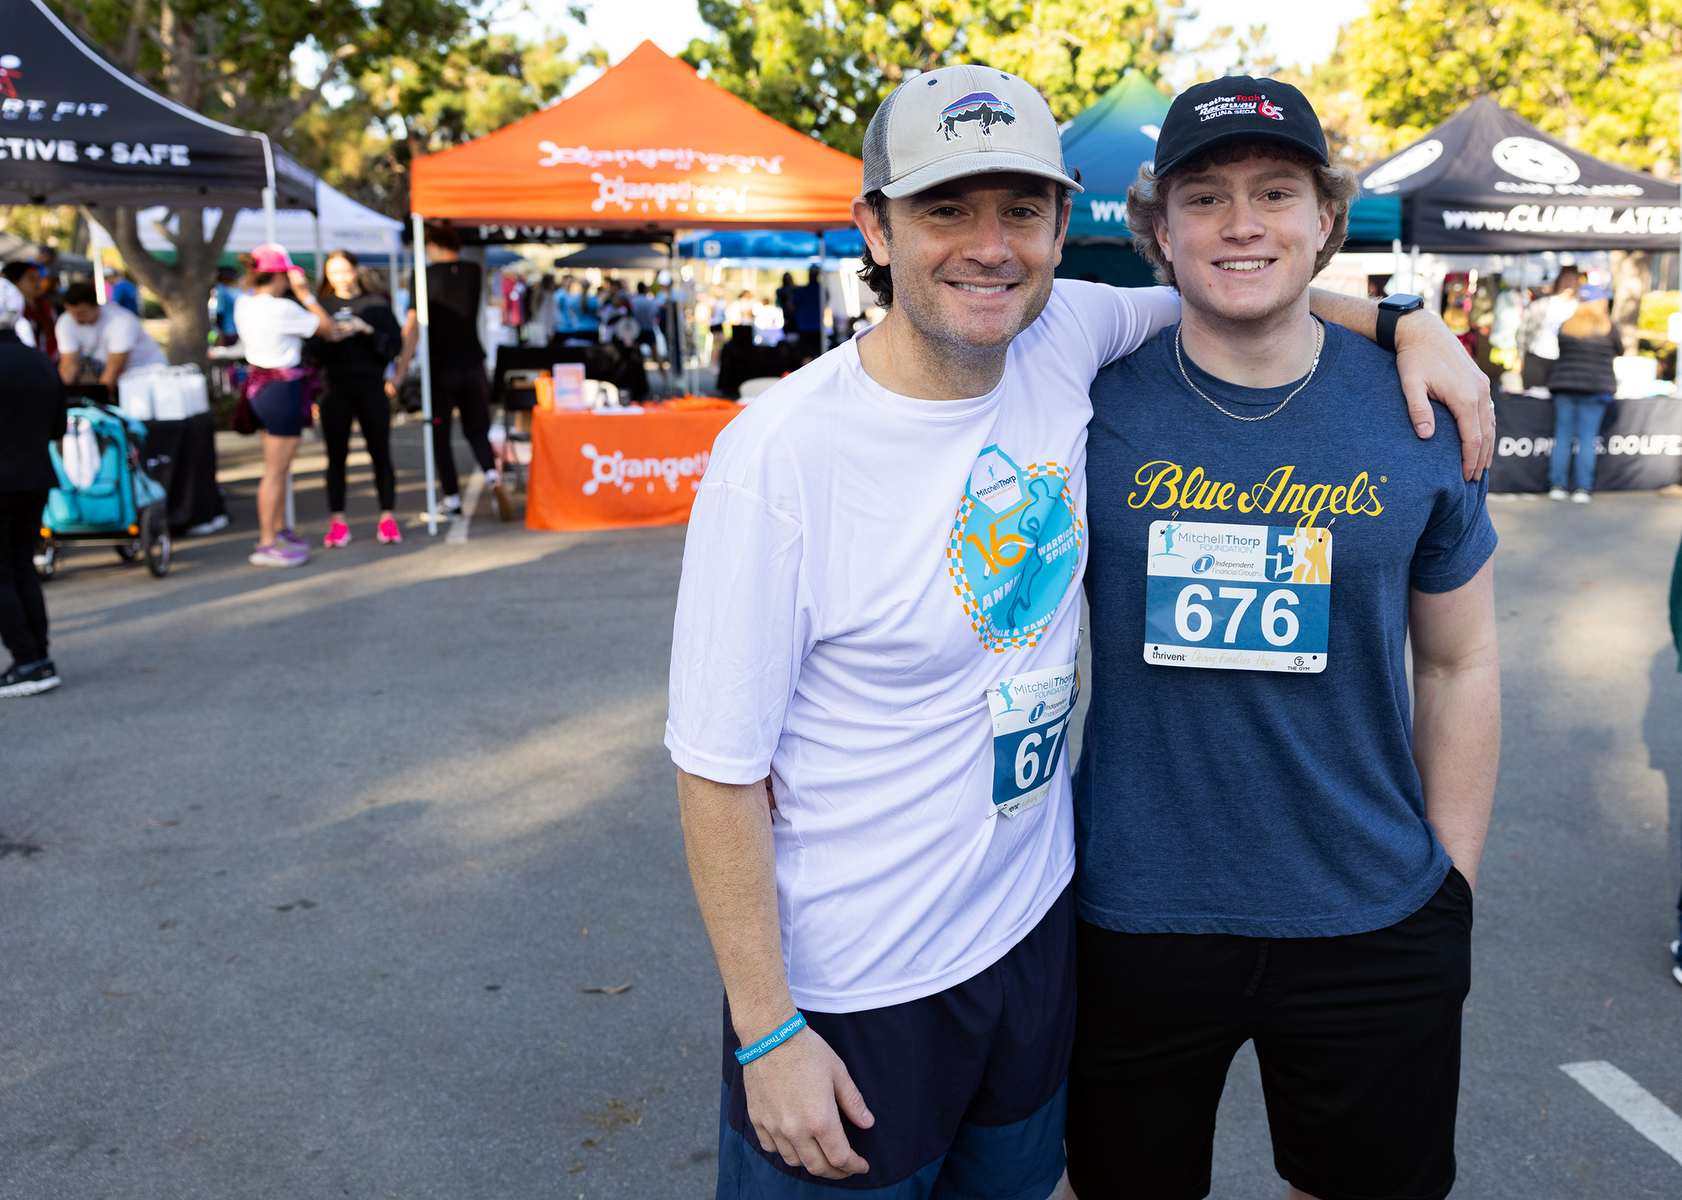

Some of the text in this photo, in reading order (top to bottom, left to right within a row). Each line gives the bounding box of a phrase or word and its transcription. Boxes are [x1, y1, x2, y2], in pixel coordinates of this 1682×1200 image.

[52, 101, 109, 121] FIT
[1194, 94, 1260, 111] WeatherTech
[1199, 102, 1257, 116] Raceway
[1201, 109, 1233, 121] LAGUNA
[111, 142, 191, 166] SAFE
[590, 174, 750, 212] Orangetheory
[1498, 436, 1533, 457] DO
[1128, 460, 1384, 528] Blue Angels
[965, 522, 1027, 575] 16
[1038, 526, 1073, 556] WARRIOR
[1045, 536, 1074, 564] SPIRIT
[1200, 544, 1253, 554] FOUNDATION
[1215, 560, 1254, 568] Independent
[1175, 584, 1300, 647] 676
[1013, 628, 1020, 636] &
[1152, 651, 1186, 662] thrivent
[779, 1017, 803, 1038] Mitchell
[760, 1035, 781, 1049] Thorp
